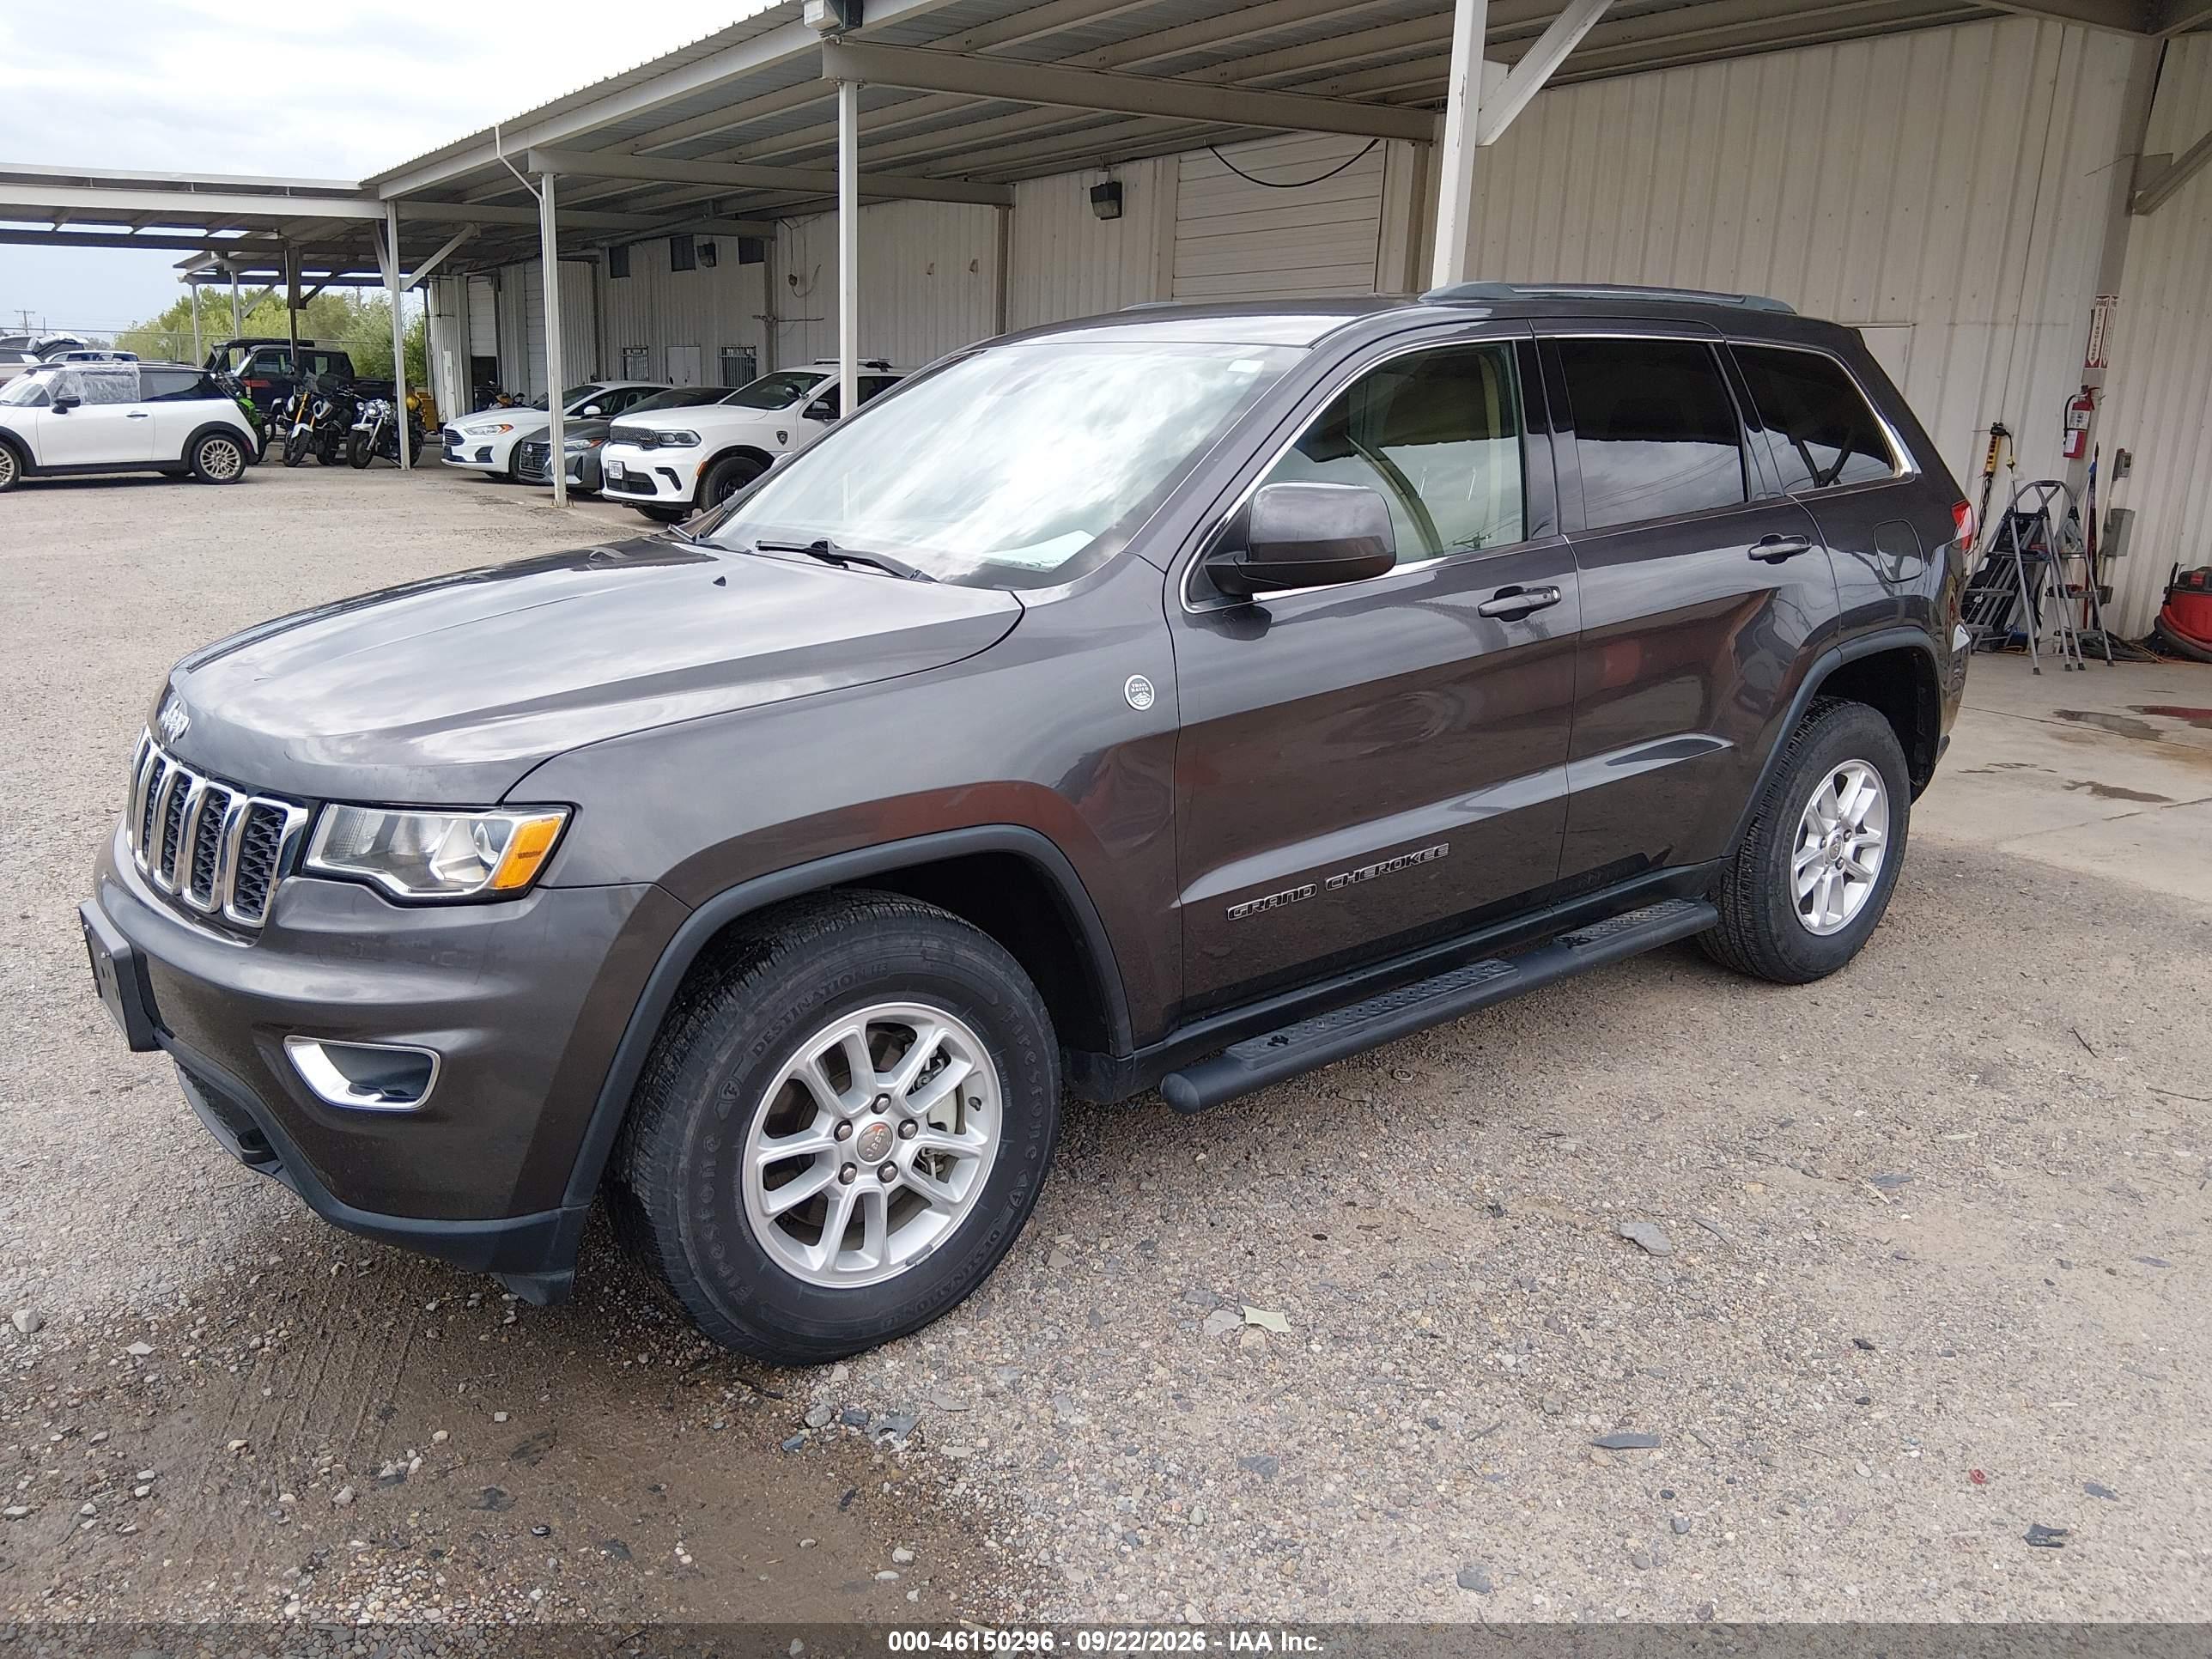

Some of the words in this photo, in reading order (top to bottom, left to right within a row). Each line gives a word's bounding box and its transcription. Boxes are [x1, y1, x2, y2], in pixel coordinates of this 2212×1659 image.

[1226, 883, 1318, 921] GRAND
[1325, 842, 1449, 890] CHEROKEE
[752, 968, 868, 1057] DESTINATION
[1001, 1003, 1044, 1160] Firestone
